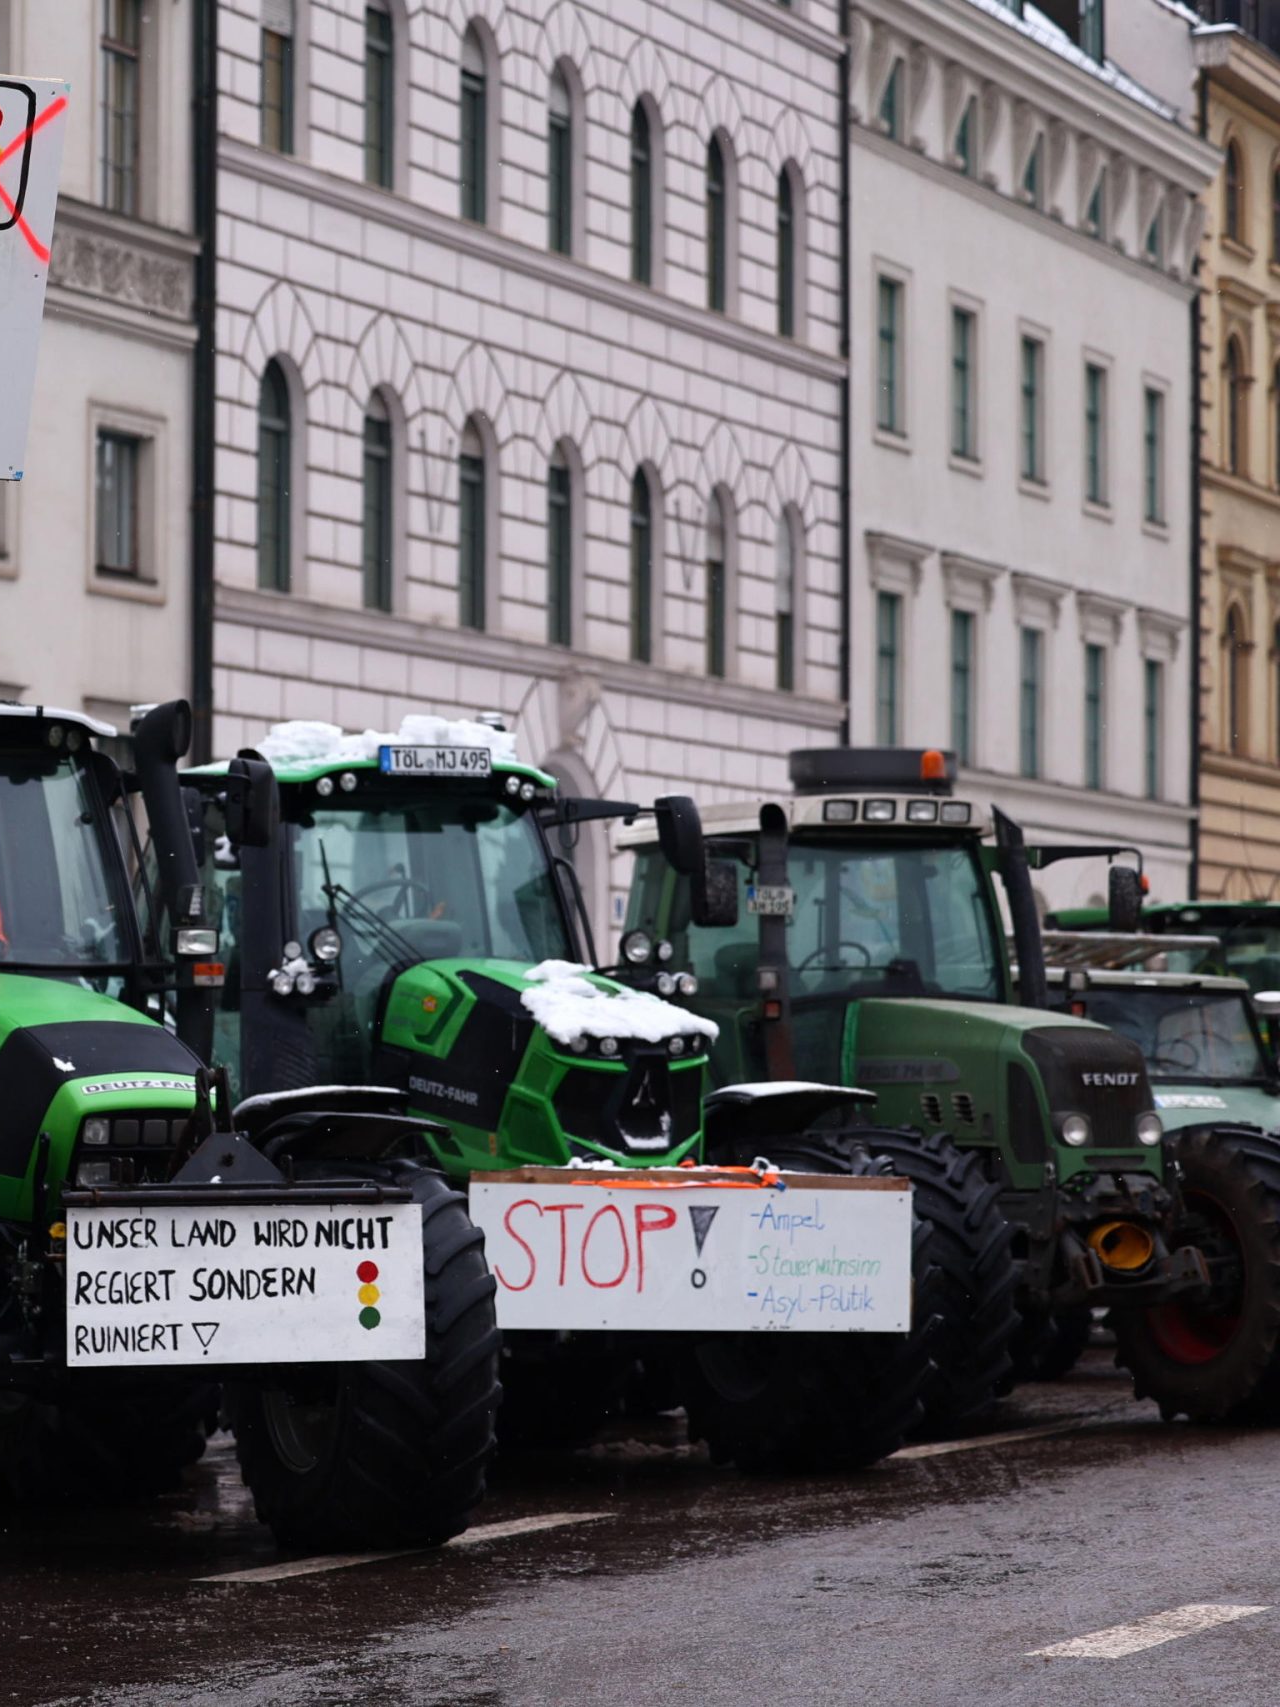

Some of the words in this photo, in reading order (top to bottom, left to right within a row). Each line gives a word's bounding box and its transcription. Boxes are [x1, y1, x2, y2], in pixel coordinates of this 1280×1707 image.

[392, 750, 423, 769] TÖL
[436, 750, 457, 769] MJ
[460, 751, 488, 770] 495
[85, 1080, 197, 1093] DEUTZ-FAH
[408, 1074, 479, 1107] DEUTZ-FAHR
[1081, 1072, 1139, 1087] FENDT
[74, 1218, 158, 1250] UNSER
[171, 1219, 236, 1247] LAND
[254, 1219, 308, 1248] WIRD
[314, 1216, 394, 1250] NICHT
[75, 1269, 176, 1305] REGIERT
[189, 1266, 315, 1301] SONDERN
